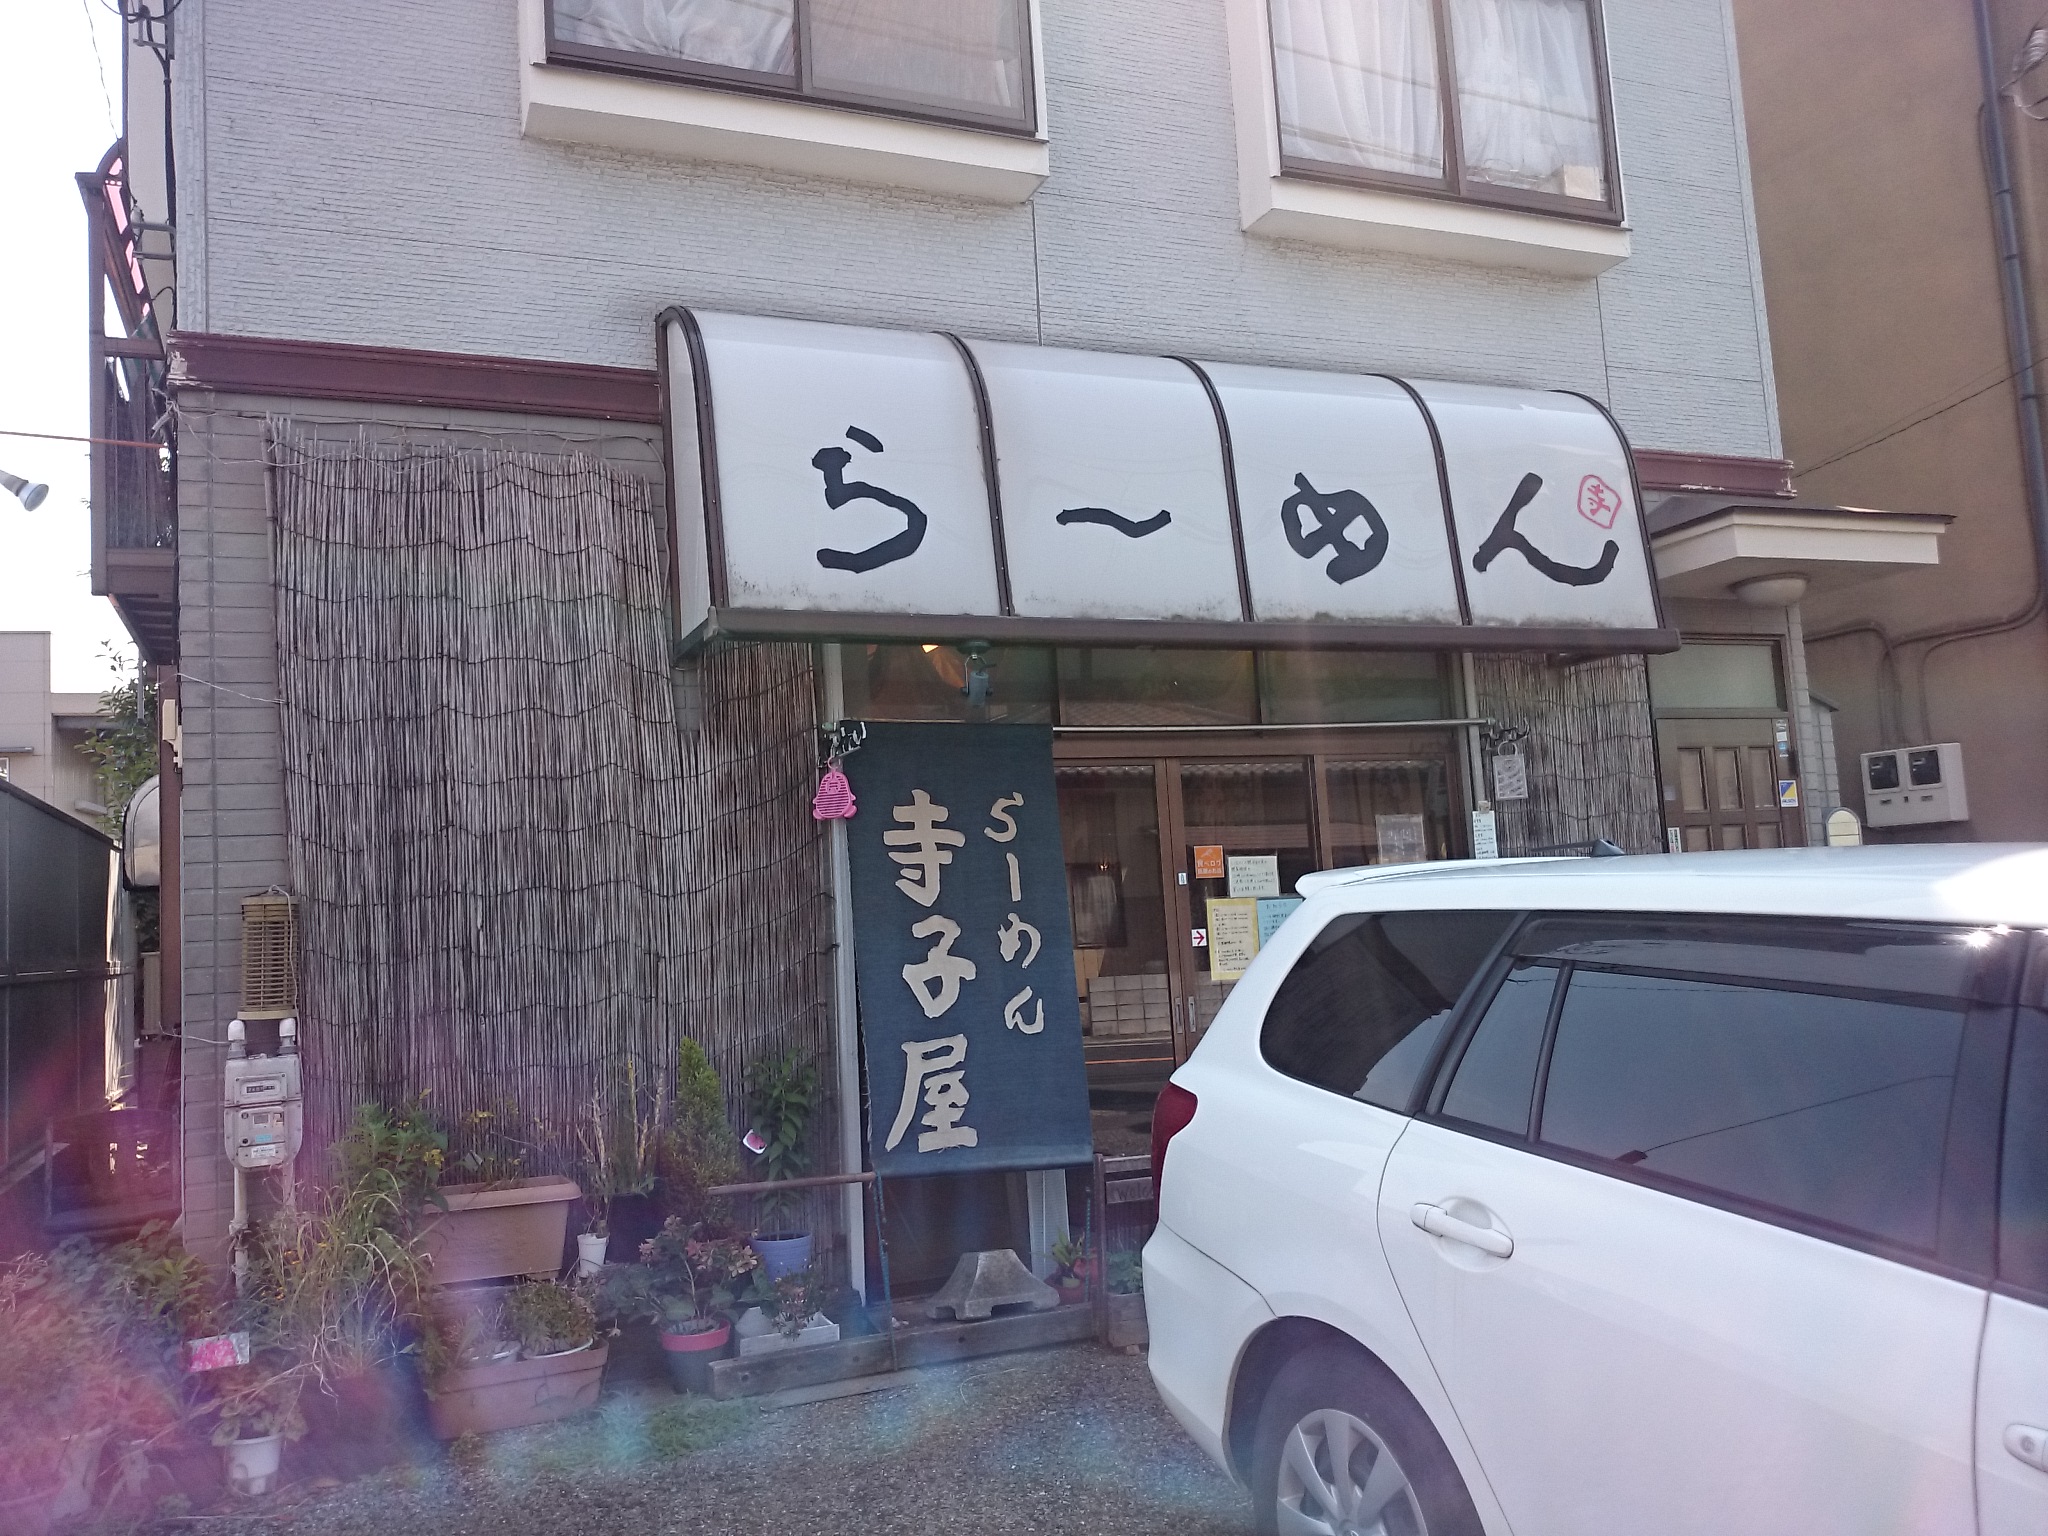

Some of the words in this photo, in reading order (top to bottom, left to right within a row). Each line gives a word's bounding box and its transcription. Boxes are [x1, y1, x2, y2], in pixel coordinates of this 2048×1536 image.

[812, 426, 1619, 586] らーめん
[883, 788, 978, 1153] 寺子屋
[983, 791, 1044, 1034] らーめん
